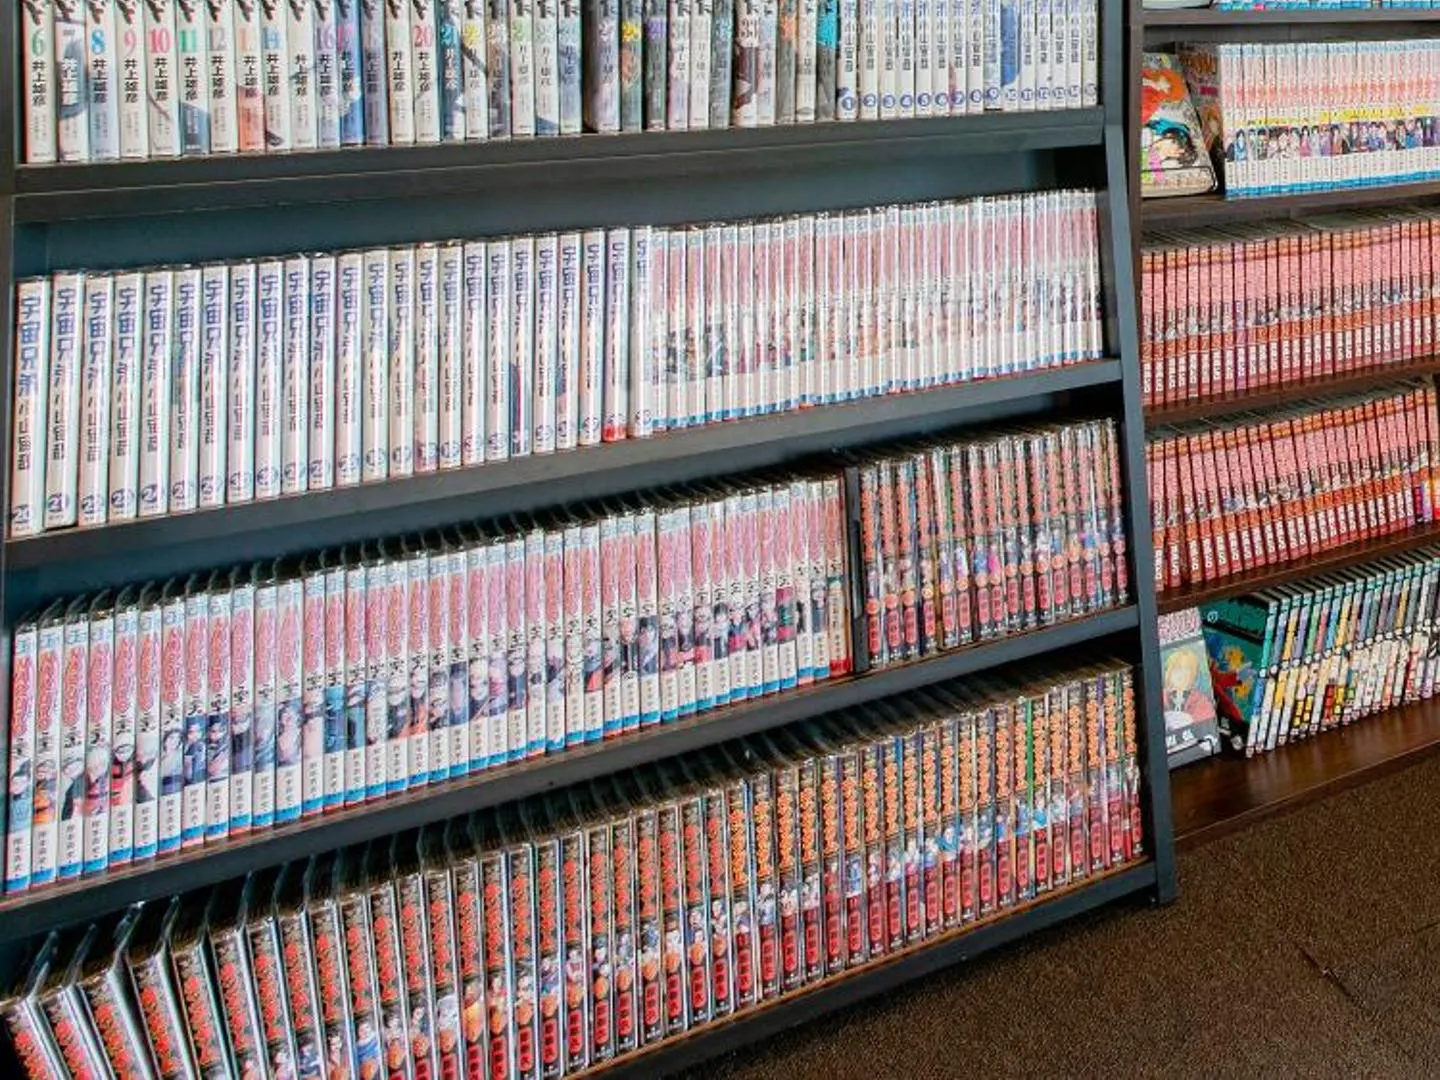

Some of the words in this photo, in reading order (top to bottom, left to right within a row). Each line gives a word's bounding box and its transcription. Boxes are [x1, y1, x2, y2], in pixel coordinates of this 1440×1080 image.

[31, 27, 46, 56] 6
[90, 29, 106, 56] 8
[123, 27, 138, 56] 9
[150, 27, 172, 55] 10
[178, 29, 198, 53] 11
[208, 28, 228, 53] 12
[414, 23, 432, 48] 20
[32, 59, 47, 107] 井上雄彦
[124, 58, 138, 103] 井上雄彦
